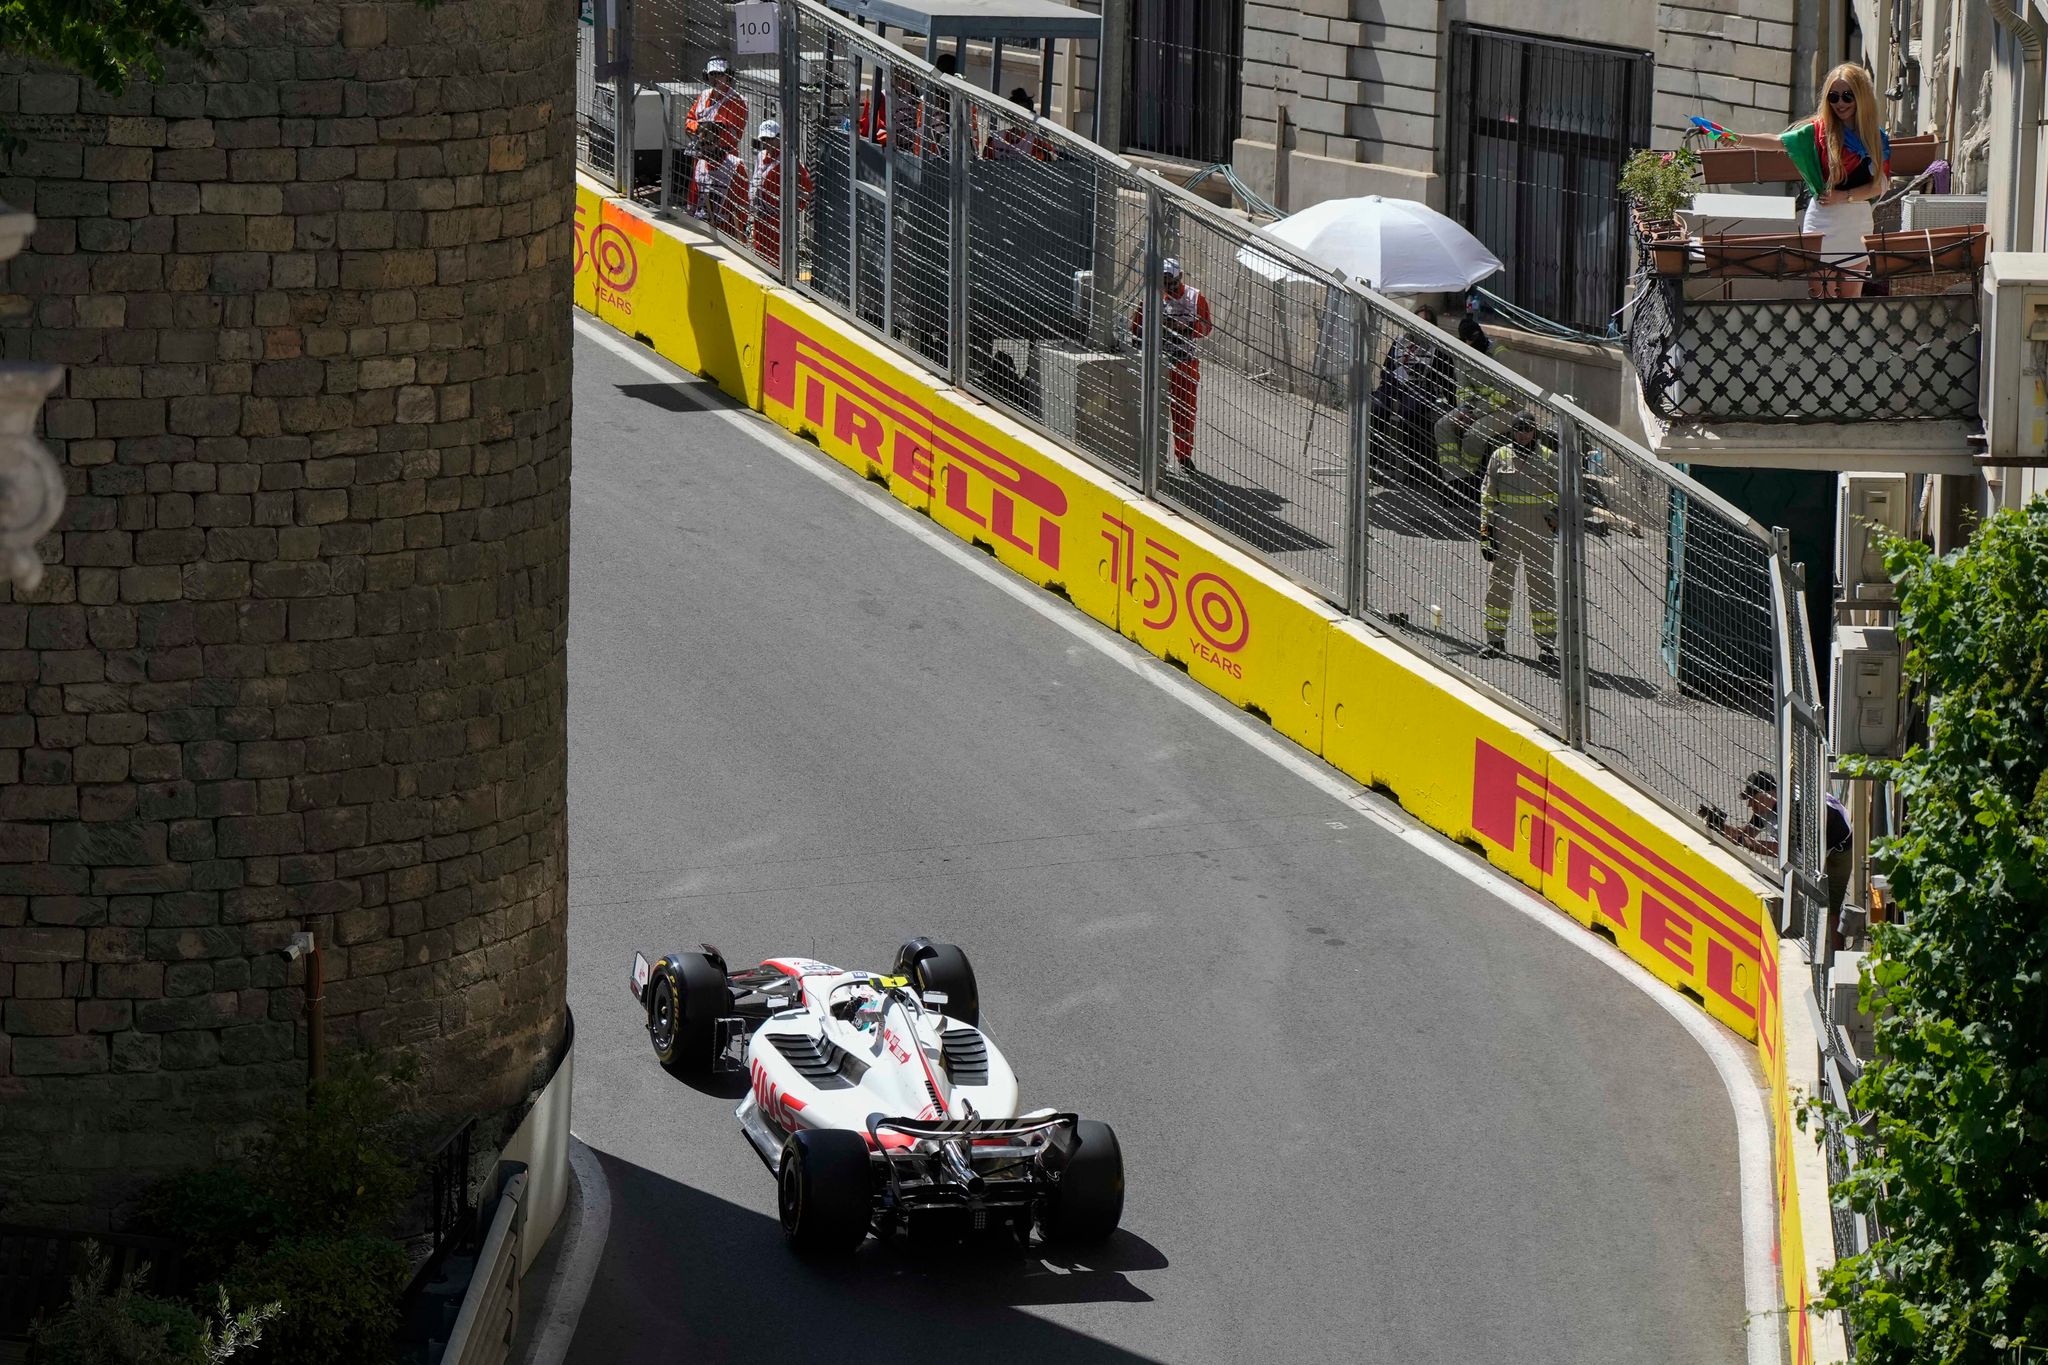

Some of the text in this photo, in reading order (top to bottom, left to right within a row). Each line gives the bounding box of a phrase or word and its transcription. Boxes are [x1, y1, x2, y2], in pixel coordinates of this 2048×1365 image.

[740, 21, 770, 35] 10.0
[592, 281, 632, 315] YEARS
[763, 313, 1068, 571] PIRELLI
[1101, 511, 1249, 652] 150
[1190, 637, 1242, 680] YEARS
[751, 1057, 808, 1134] HAAS
